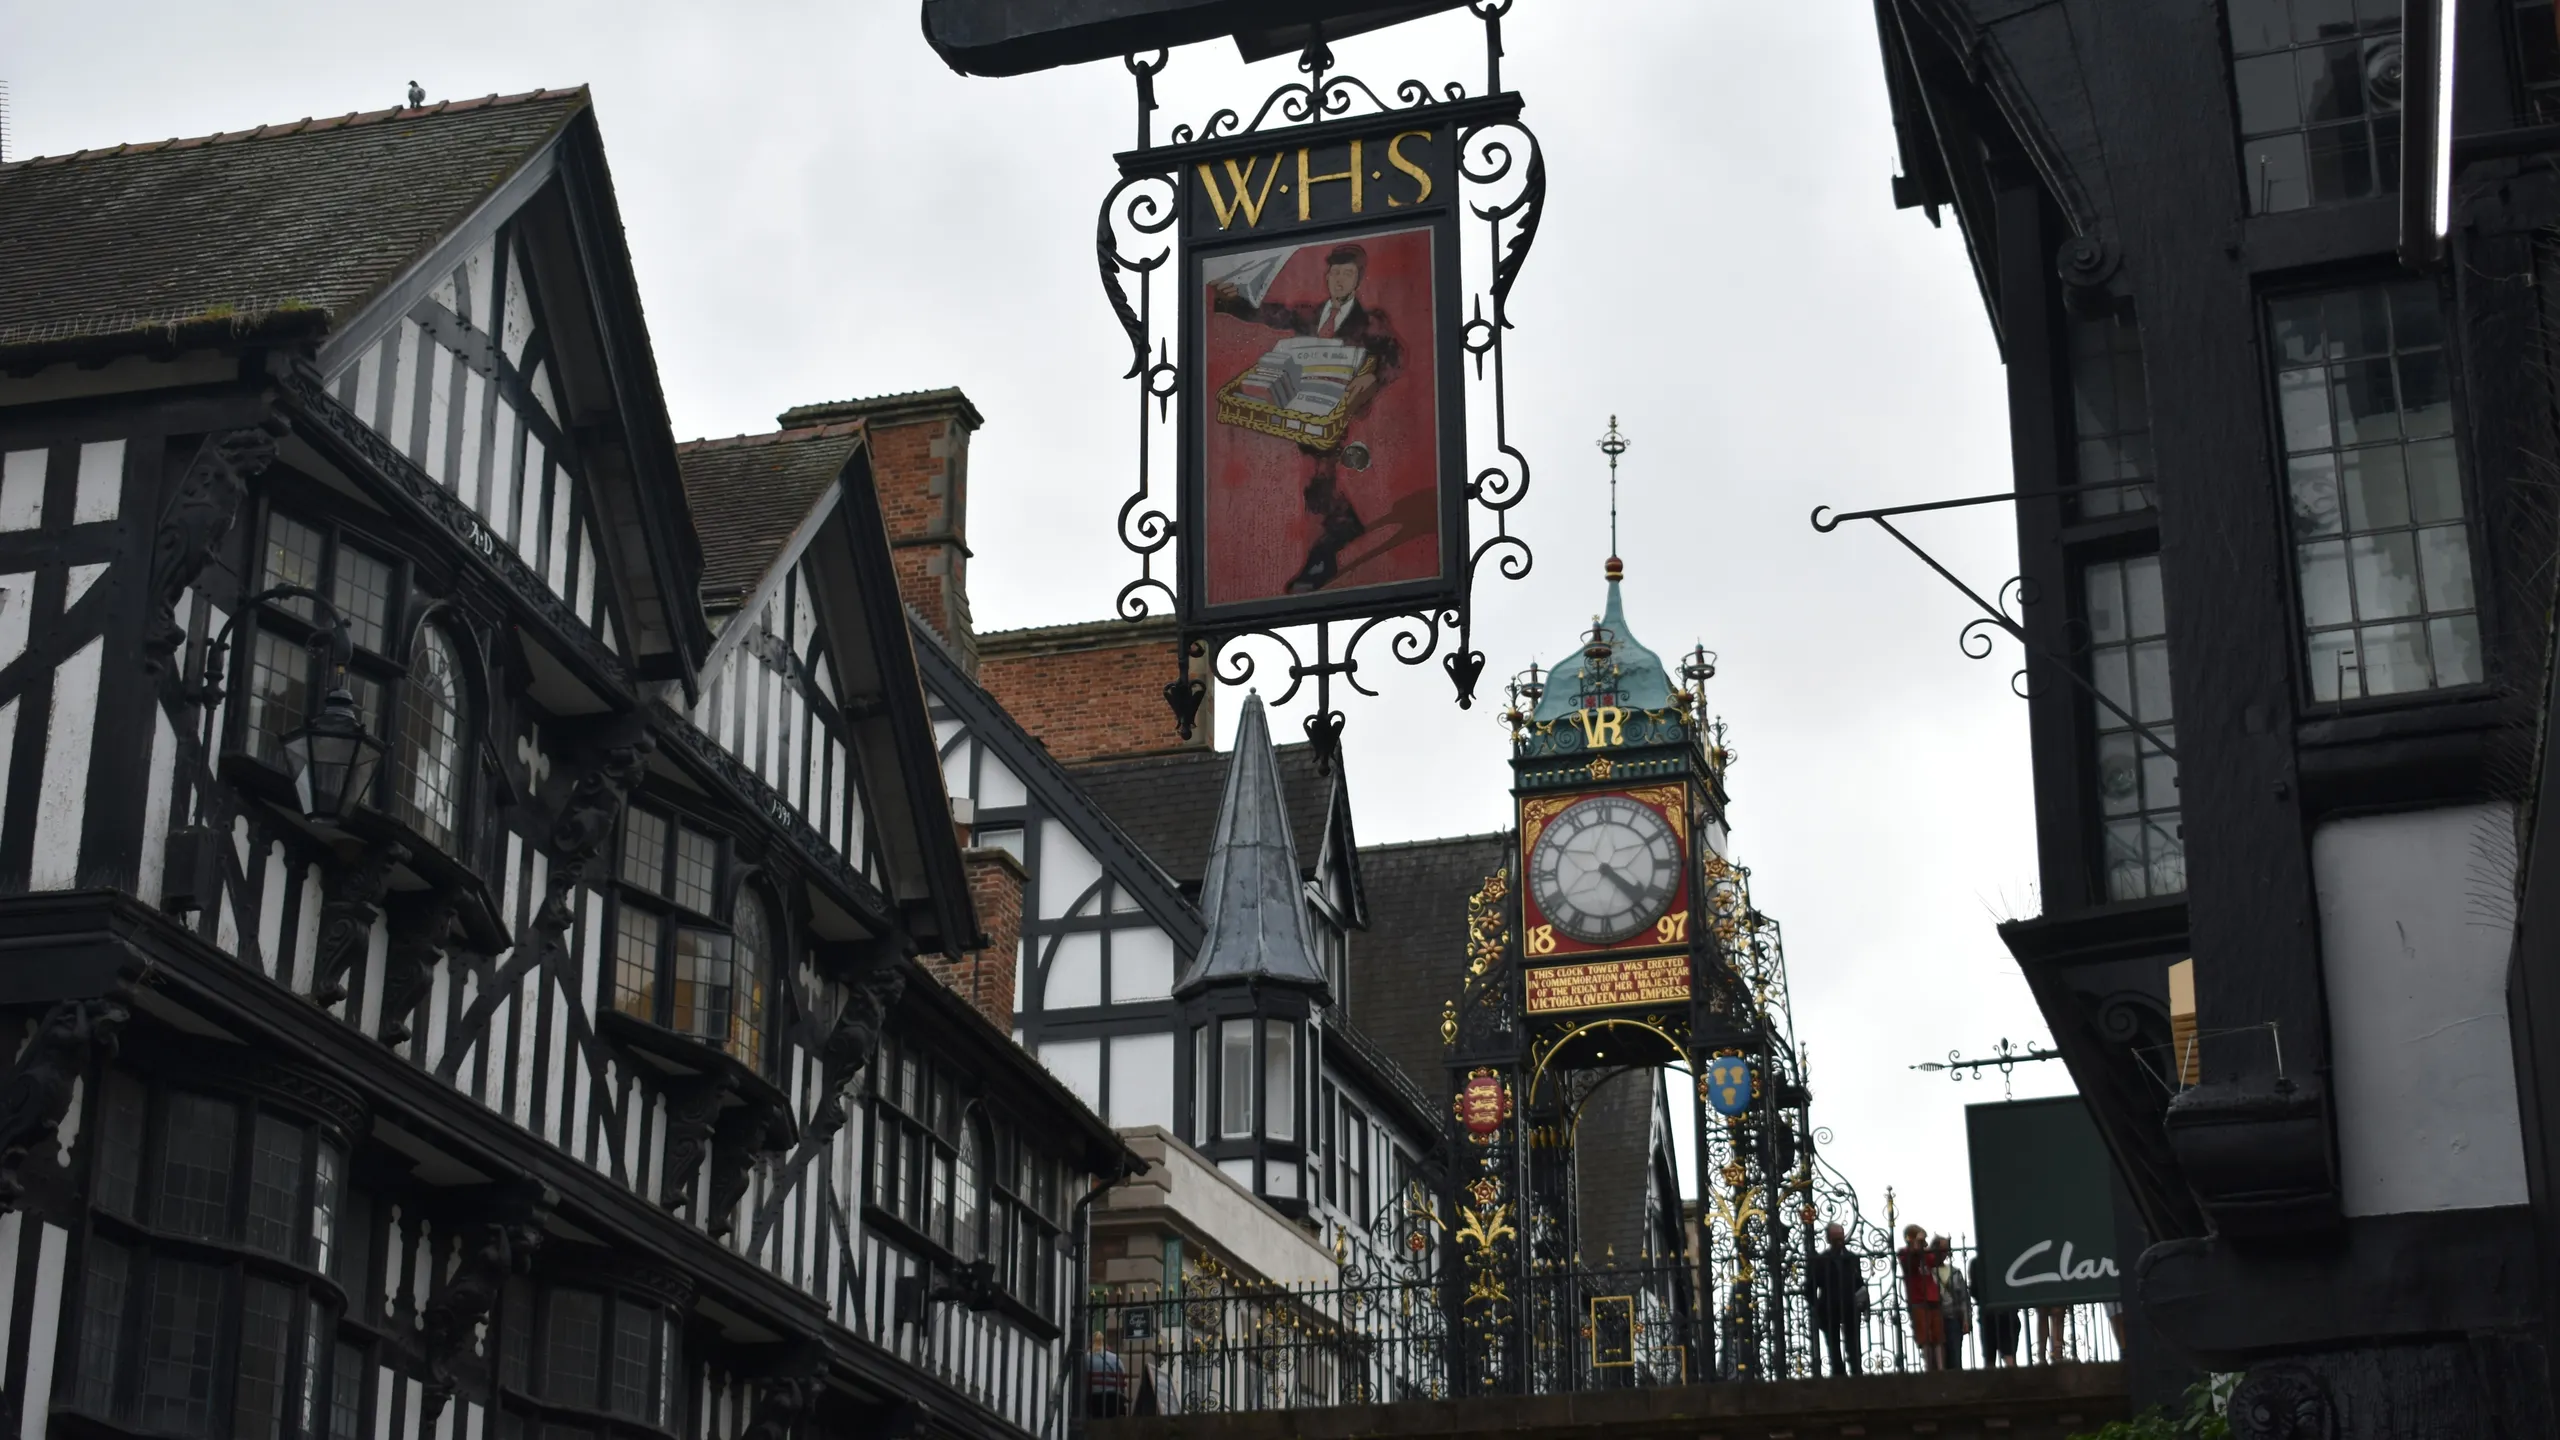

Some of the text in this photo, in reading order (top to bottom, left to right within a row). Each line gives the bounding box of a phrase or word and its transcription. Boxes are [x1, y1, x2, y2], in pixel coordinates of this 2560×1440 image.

[1579, 706, 1624, 749] VR
[1526, 924, 1556, 954] 18
[1657, 910, 1688, 943] 97
[1528, 980, 1539, 989] IN
[1541, 973, 1618, 988] COMMEMORATION
[1619, 971, 1631, 981] OF
[1632, 970, 1649, 980] THE
[1666, 966, 1689, 977] YEAR
[1533, 957, 1684, 979] THIS CLOCK TOWER WAS ERECTED
[1530, 995, 1582, 1009] VICTORIA
[1619, 992, 1639, 1001] AND
[1640, 985, 1690, 1000] EMPRESS
[1536, 976, 1681, 997] OF THE REIGN OF HER MAJESTY
[2005, 1239, 2119, 1287] Clar
